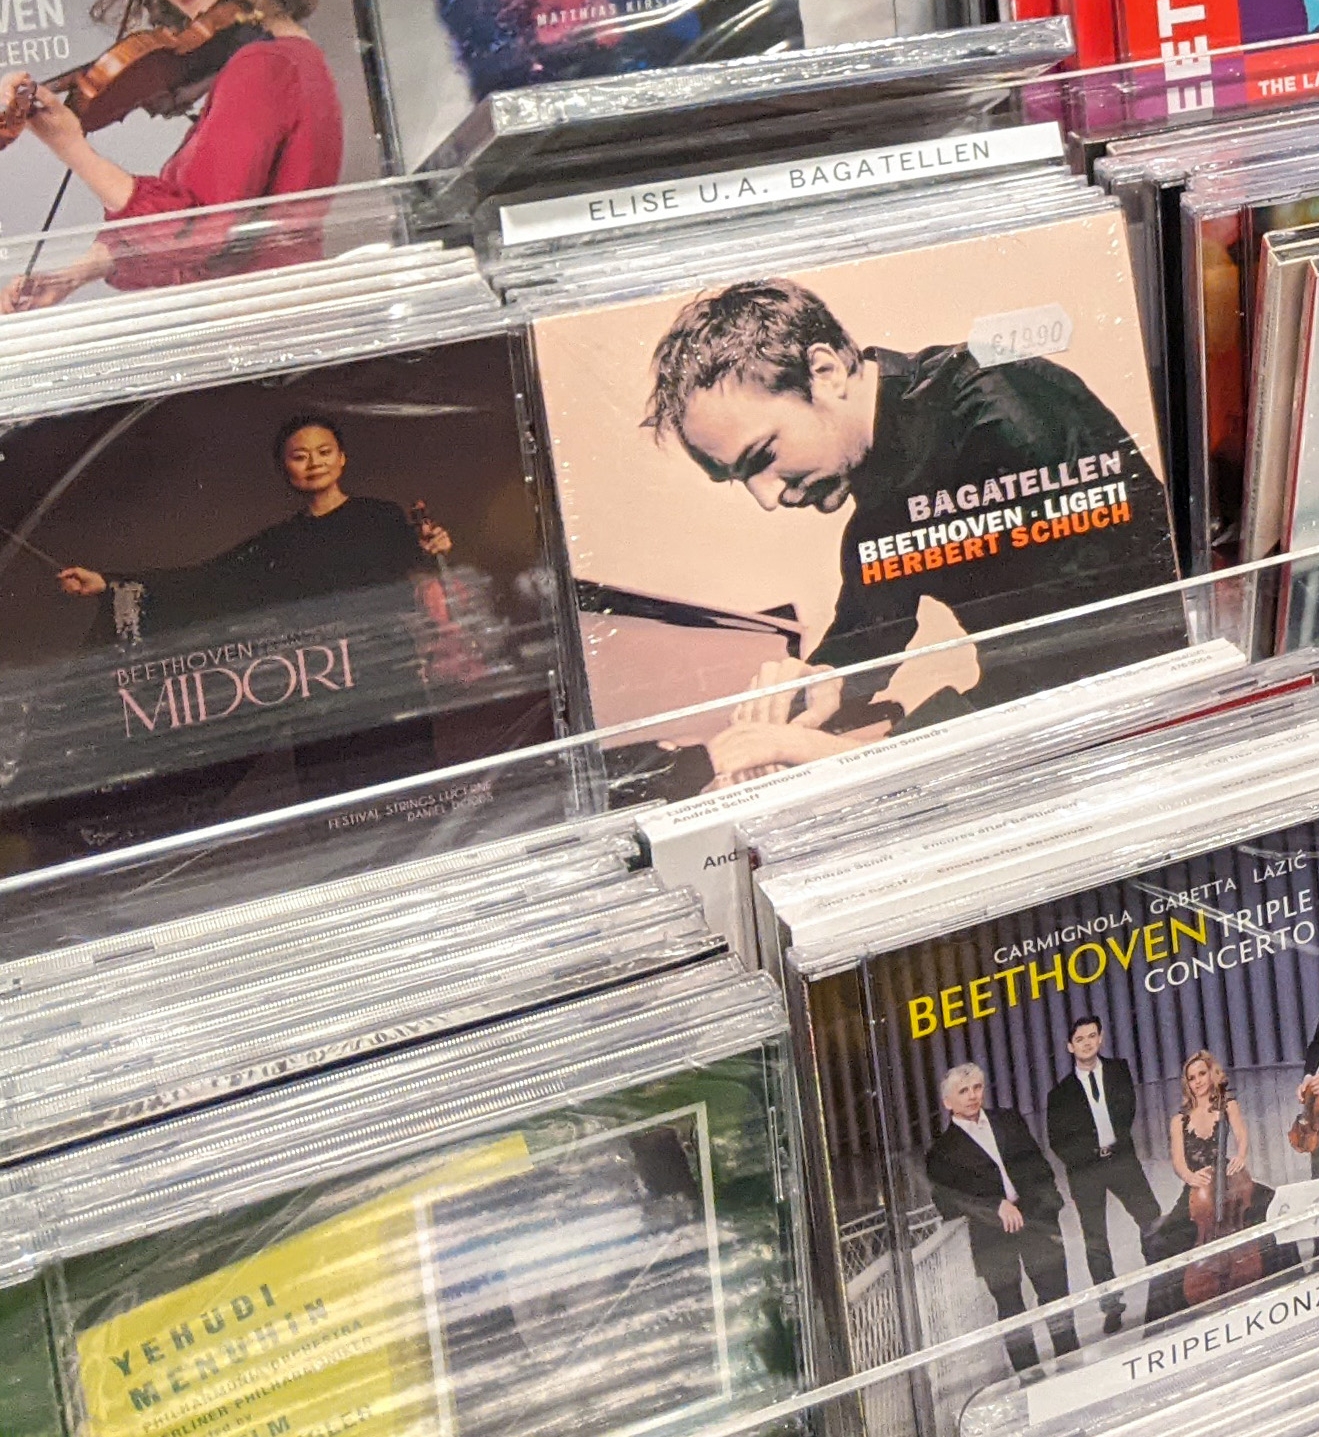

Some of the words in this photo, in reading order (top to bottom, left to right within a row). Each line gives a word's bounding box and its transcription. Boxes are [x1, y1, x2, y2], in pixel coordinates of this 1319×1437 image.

[1259, 79, 1297, 96] THE
[588, 188, 680, 222] ELISE
[699, 179, 769, 204] U.A.
[789, 140, 991, 189] BAGATELLEN
[858, 510, 1022, 563] BEETHOVEN
[1044, 482, 1127, 519] LIGETI
[909, 449, 1122, 521] BAGATELLEN
[861, 534, 1000, 584] HERBERT
[1010, 502, 1131, 548] SCHUCH
[115, 641, 253, 687] BEETHOVEN
[118, 638, 354, 737] MIDORI
[993, 911, 1132, 964] CARMIGNOLA
[1150, 876, 1236, 915] GABETTA
[1251, 851, 1307, 884] LAZIĆ
[907, 910, 1208, 1039] BEETHOVEN
[1218, 889, 1313, 939] TRIPLE
[1143, 920, 1315, 993] CONCERTO
[108, 1284, 276, 1377] YEHUDI
